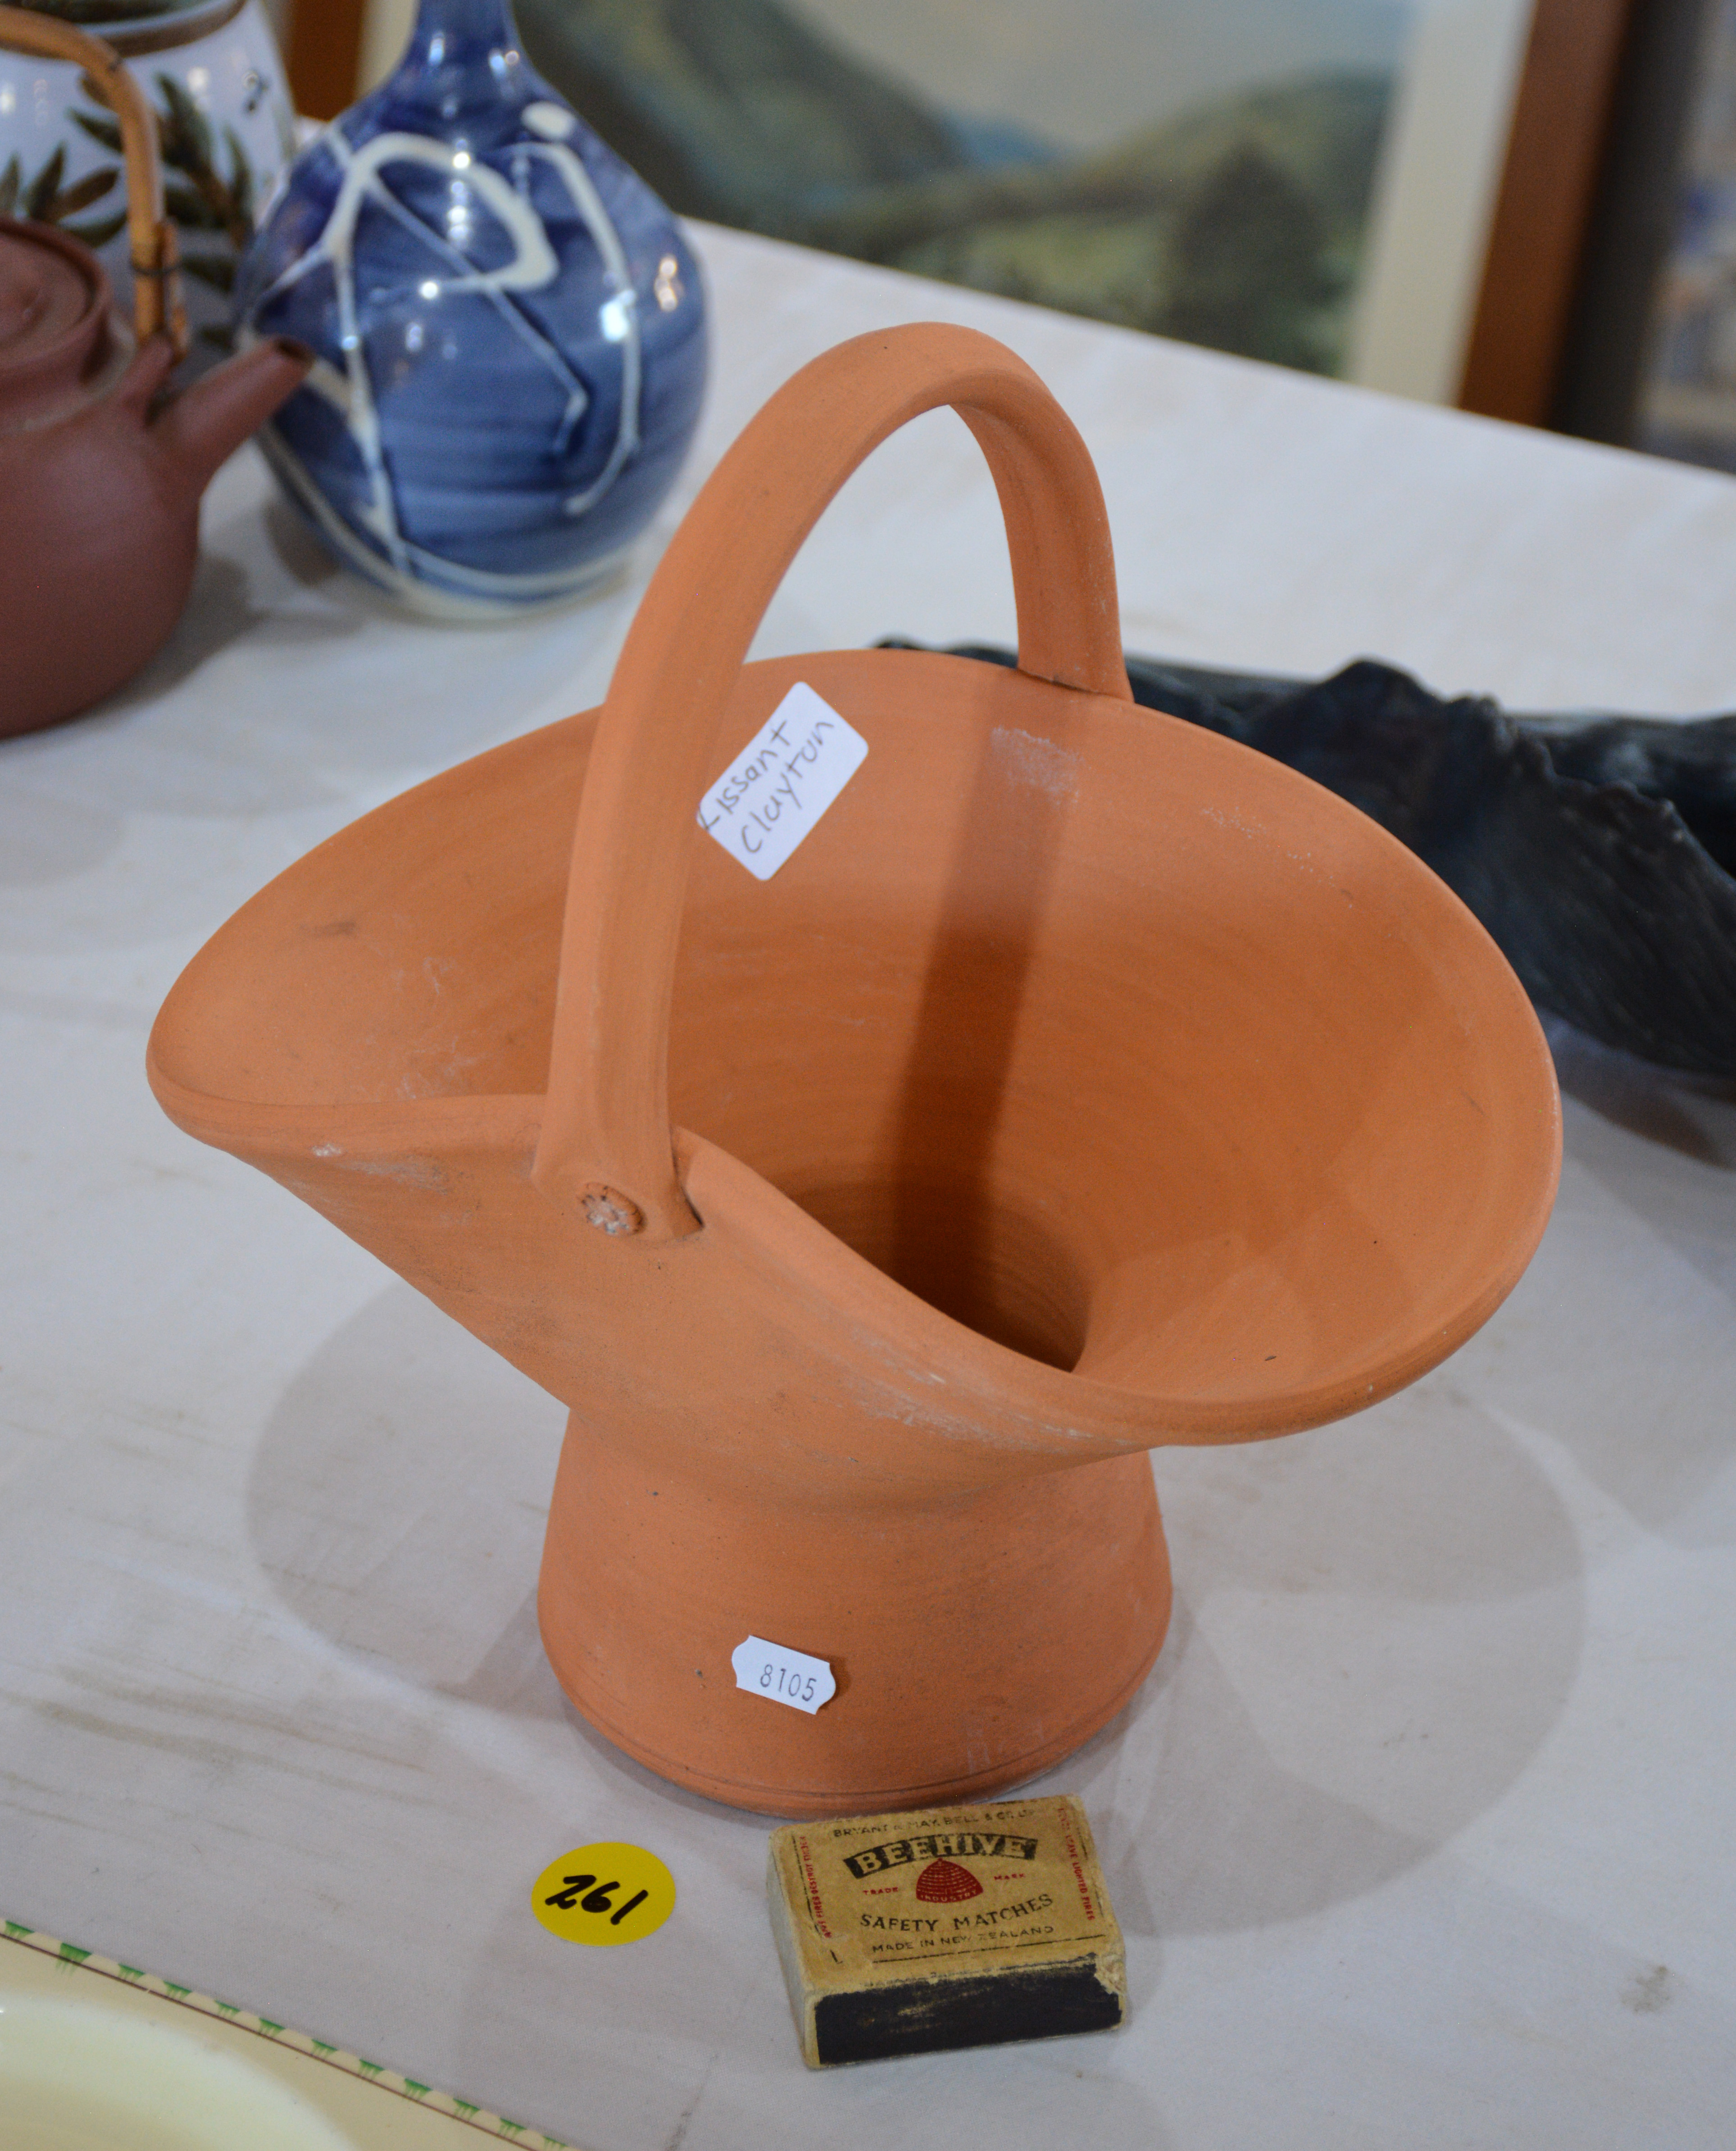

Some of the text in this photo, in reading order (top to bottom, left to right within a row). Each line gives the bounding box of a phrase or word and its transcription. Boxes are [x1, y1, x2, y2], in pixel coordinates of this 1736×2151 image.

[760, 1664, 817, 1701] 8105
[834, 1824, 887, 1837] BRYANT
[854, 1835, 1026, 1874] BEEHIVE
[545, 1875, 649, 1925] 261
[863, 1887, 898, 1895] TRADE
[920, 1890, 977, 1902] INDUSTRY
[1072, 1862, 1088, 1894] LIGHTED
[1082, 1896, 1095, 1920] FIRES
[860, 1914, 939, 1932] SAFETY
[954, 1893, 1053, 1930] MATCHES
[873, 1926, 1054, 1953] MADE IN NEW ZEALAND
